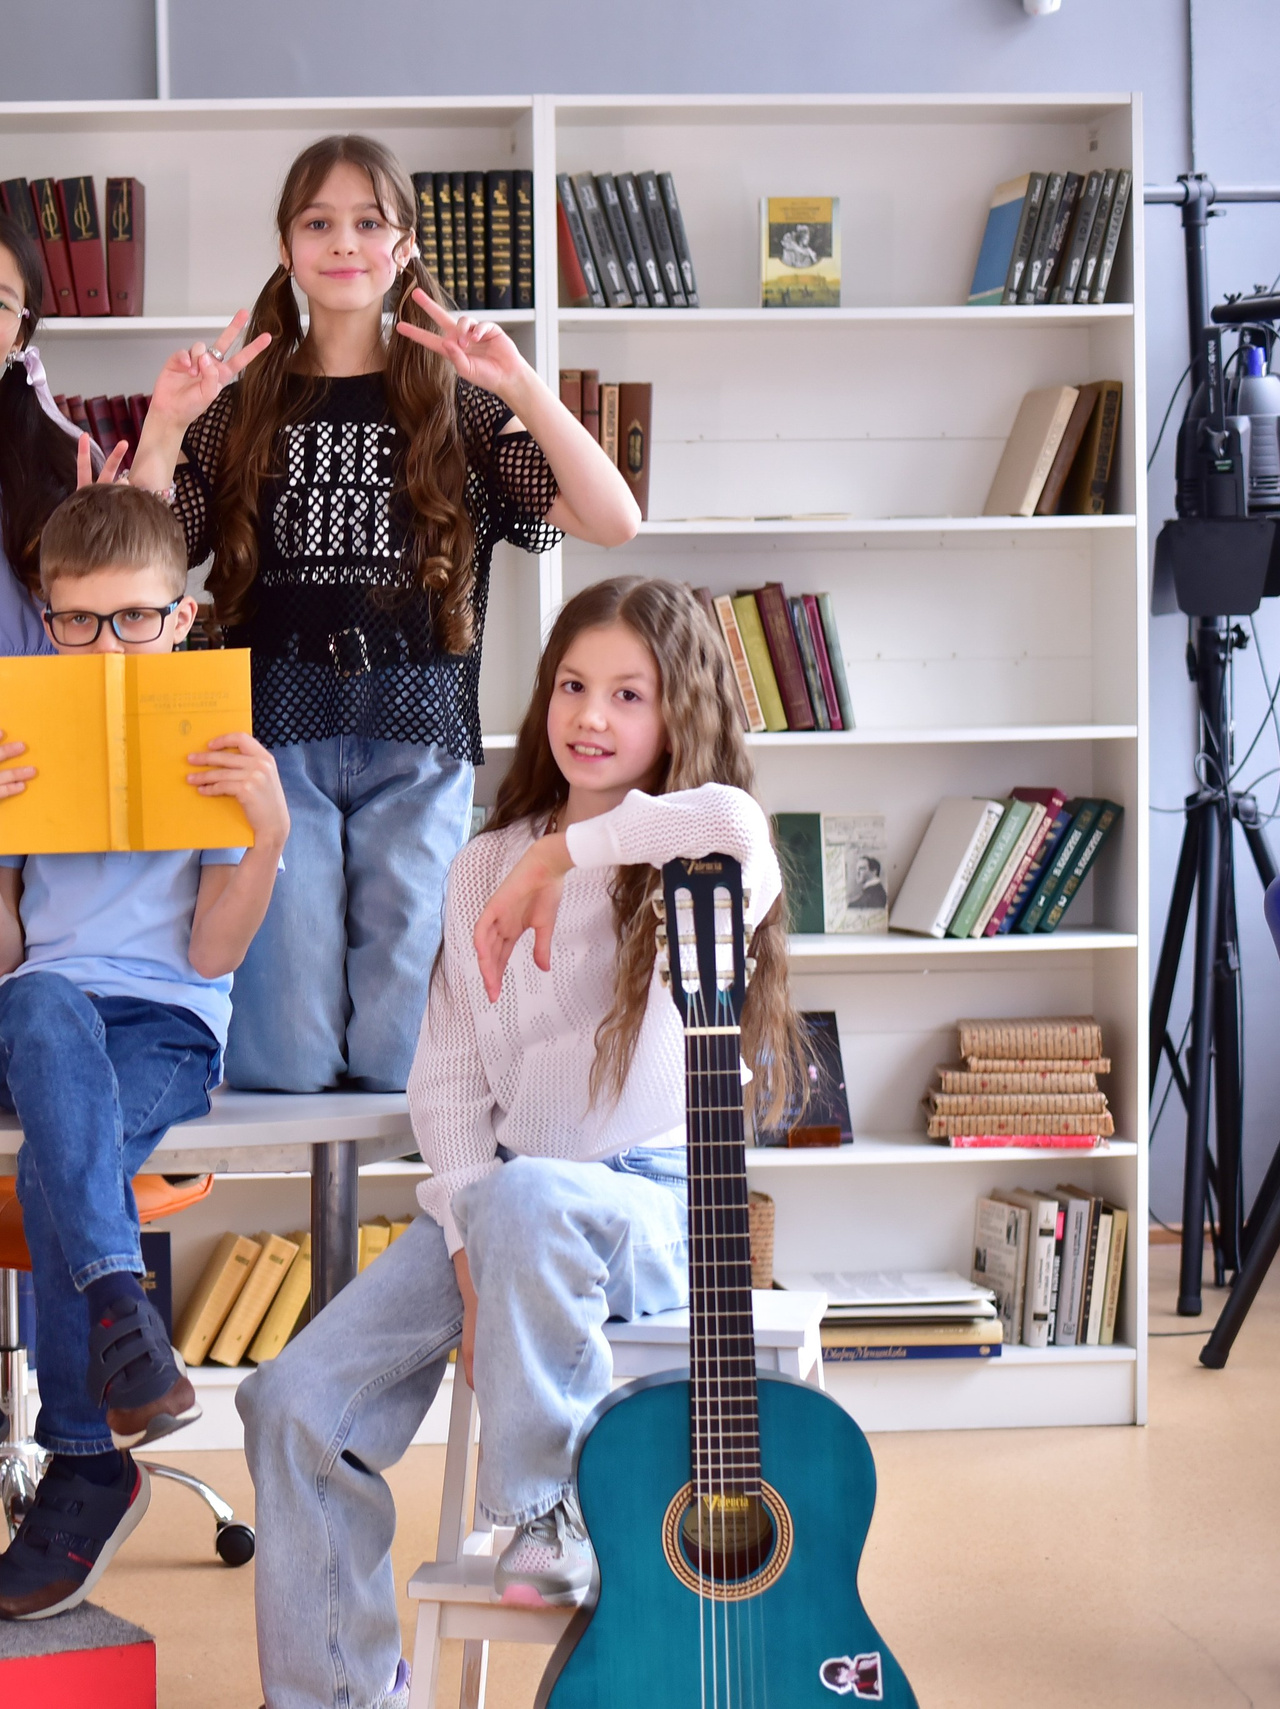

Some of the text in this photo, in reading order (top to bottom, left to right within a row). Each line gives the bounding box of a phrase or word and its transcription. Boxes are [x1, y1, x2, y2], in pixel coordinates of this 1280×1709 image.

[279, 421, 397, 488] THE
[272, 487, 405, 559] GIRL
[703, 1494, 750, 1513] Valencia
